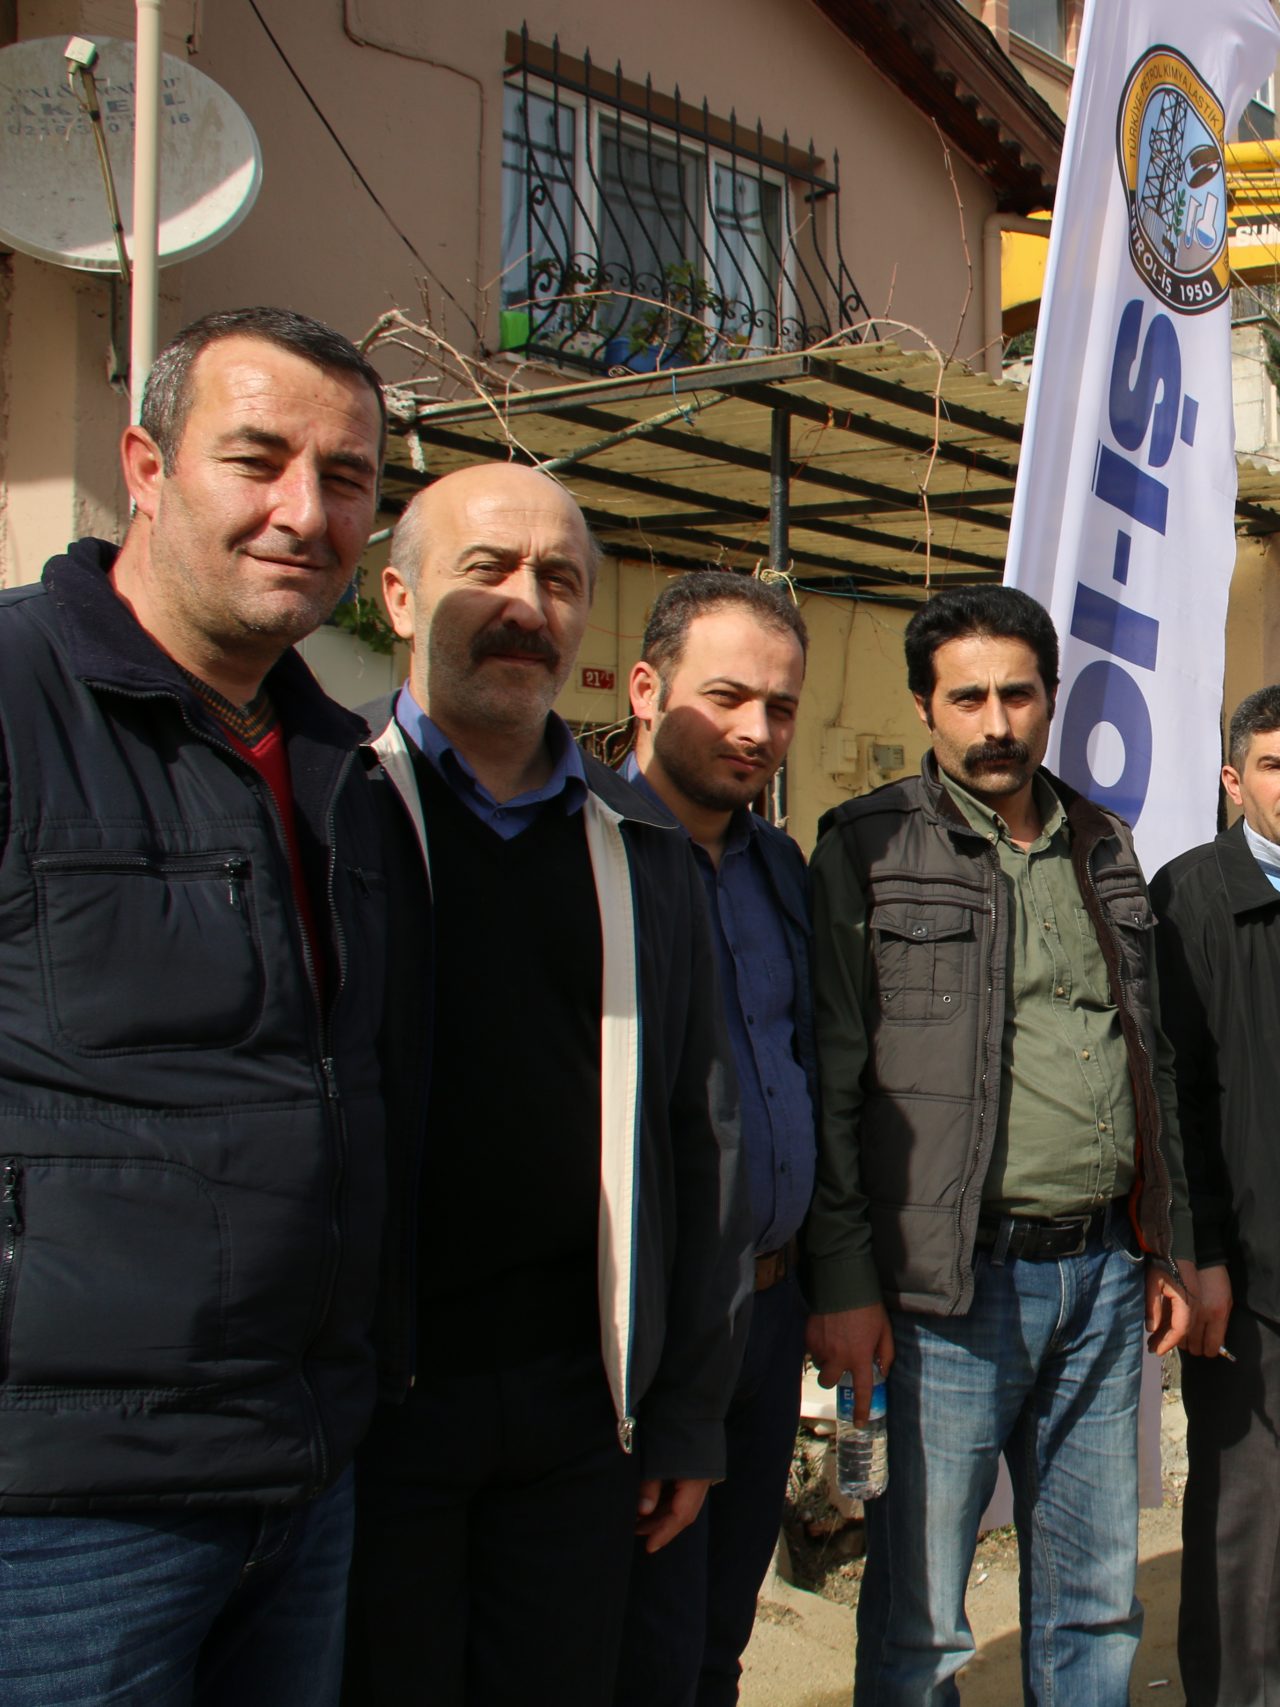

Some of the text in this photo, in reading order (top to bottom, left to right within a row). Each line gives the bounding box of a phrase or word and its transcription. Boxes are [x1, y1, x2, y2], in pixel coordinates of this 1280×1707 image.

[1127, 93, 1142, 160] TÜRKİYE
[1140, 65, 1163, 95] PETROL
[1180, 282, 1213, 302] 1950
